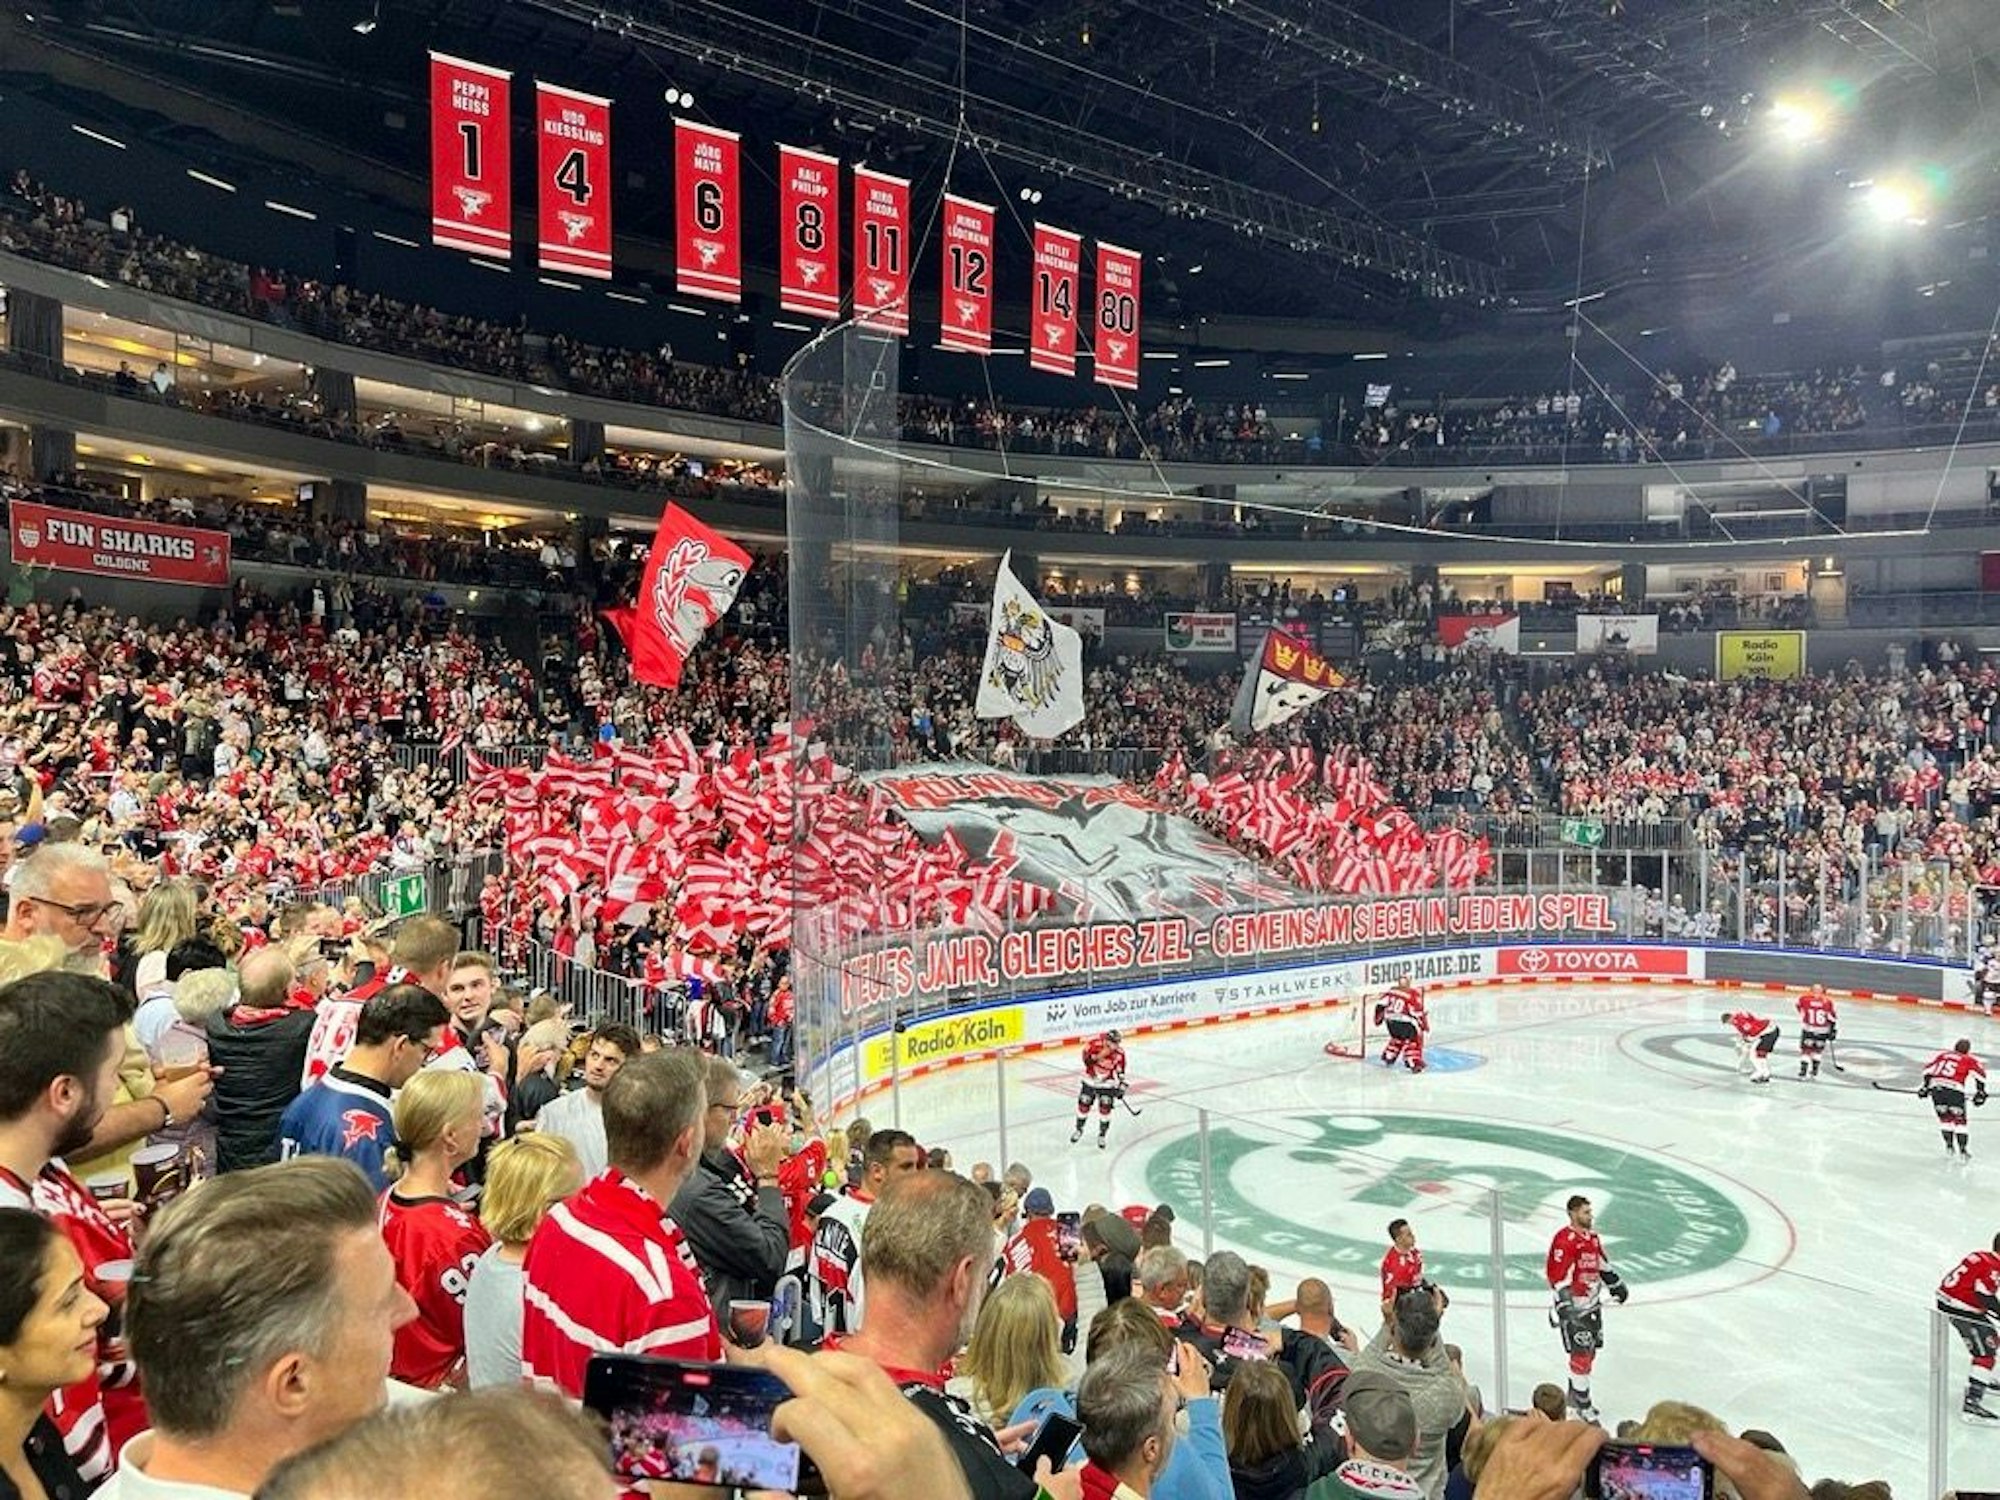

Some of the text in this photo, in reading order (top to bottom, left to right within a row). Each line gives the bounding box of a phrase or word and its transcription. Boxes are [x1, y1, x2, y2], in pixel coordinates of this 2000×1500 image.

[452, 79, 490, 101] PEPPI
[452, 94, 490, 117] HEISS
[562, 109, 587, 126] UDO
[543, 120, 605, 146] KIESSLING
[458, 121, 482, 181] 1
[554, 149, 592, 206] 4
[694, 156, 723, 175] MAYR
[798, 167, 821, 183] RALF
[792, 178, 829, 198] PHILIPP
[694, 180, 723, 233] 6
[866, 200, 900, 219] SIKORA
[796, 201, 825, 250] 8
[862, 221, 900, 273] 11
[949, 244, 986, 297] 12
[1039, 271, 1073, 320] 14
[1100, 288, 1136, 336] 80
[46, 518, 95, 547] FUN
[101, 528, 195, 560] SHARKS
[93, 553, 151, 572] COLOGNE
[1742, 640, 1778, 649] Radio
[1745, 652, 1774, 662] Köln
[1001, 923, 1135, 979] GLEICHES
[1211, 905, 1352, 958] GEMEINSAM
[1427, 898, 1448, 936] IN
[1450, 894, 1537, 932] JEDEM
[1539, 893, 1616, 931] SPIEL
[1554, 951, 1639, 969] TOYOTA
[1229, 973, 1344, 1000] STAHLWERK
[1073, 991, 1197, 1017] Vom Job zur Karriere
[1808, 1009, 1826, 1025] 16
[908, 1028, 955, 1059] Radio
[964, 1017, 1006, 1046] Köln
[1934, 1060, 1959, 1076] 15
